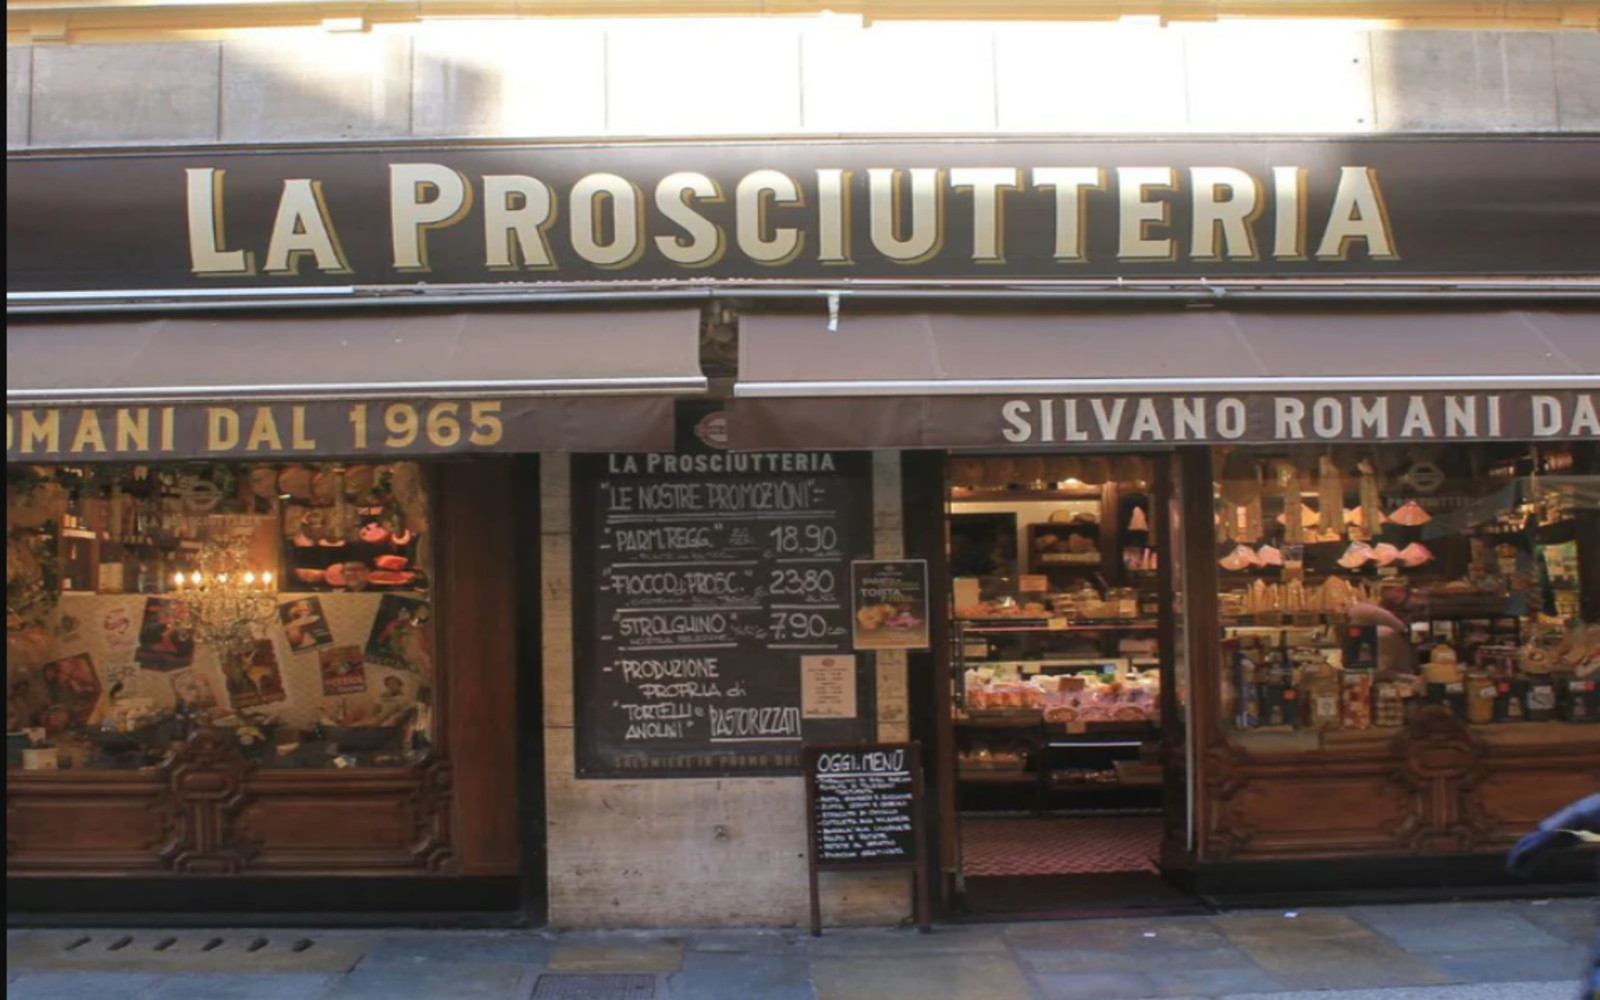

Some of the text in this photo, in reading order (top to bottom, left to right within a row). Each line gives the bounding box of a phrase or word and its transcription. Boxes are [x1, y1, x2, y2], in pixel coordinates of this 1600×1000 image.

[186, 162, 1399, 277] LA PROSCIUTTERIA
[206, 405, 315, 452] DAL
[349, 401, 504, 449] 1965
[1001, 396, 1247, 442] SILVANO
[1274, 395, 1499, 439] ROMANI
[608, 452, 836, 474] LA PROSCIUTTERIA
[639, 483, 703, 510] NOSTRE
[769, 525, 837, 553] 18.90
[769, 612, 826, 639] 7.90
[638, 682, 722, 699] PROPRIA
